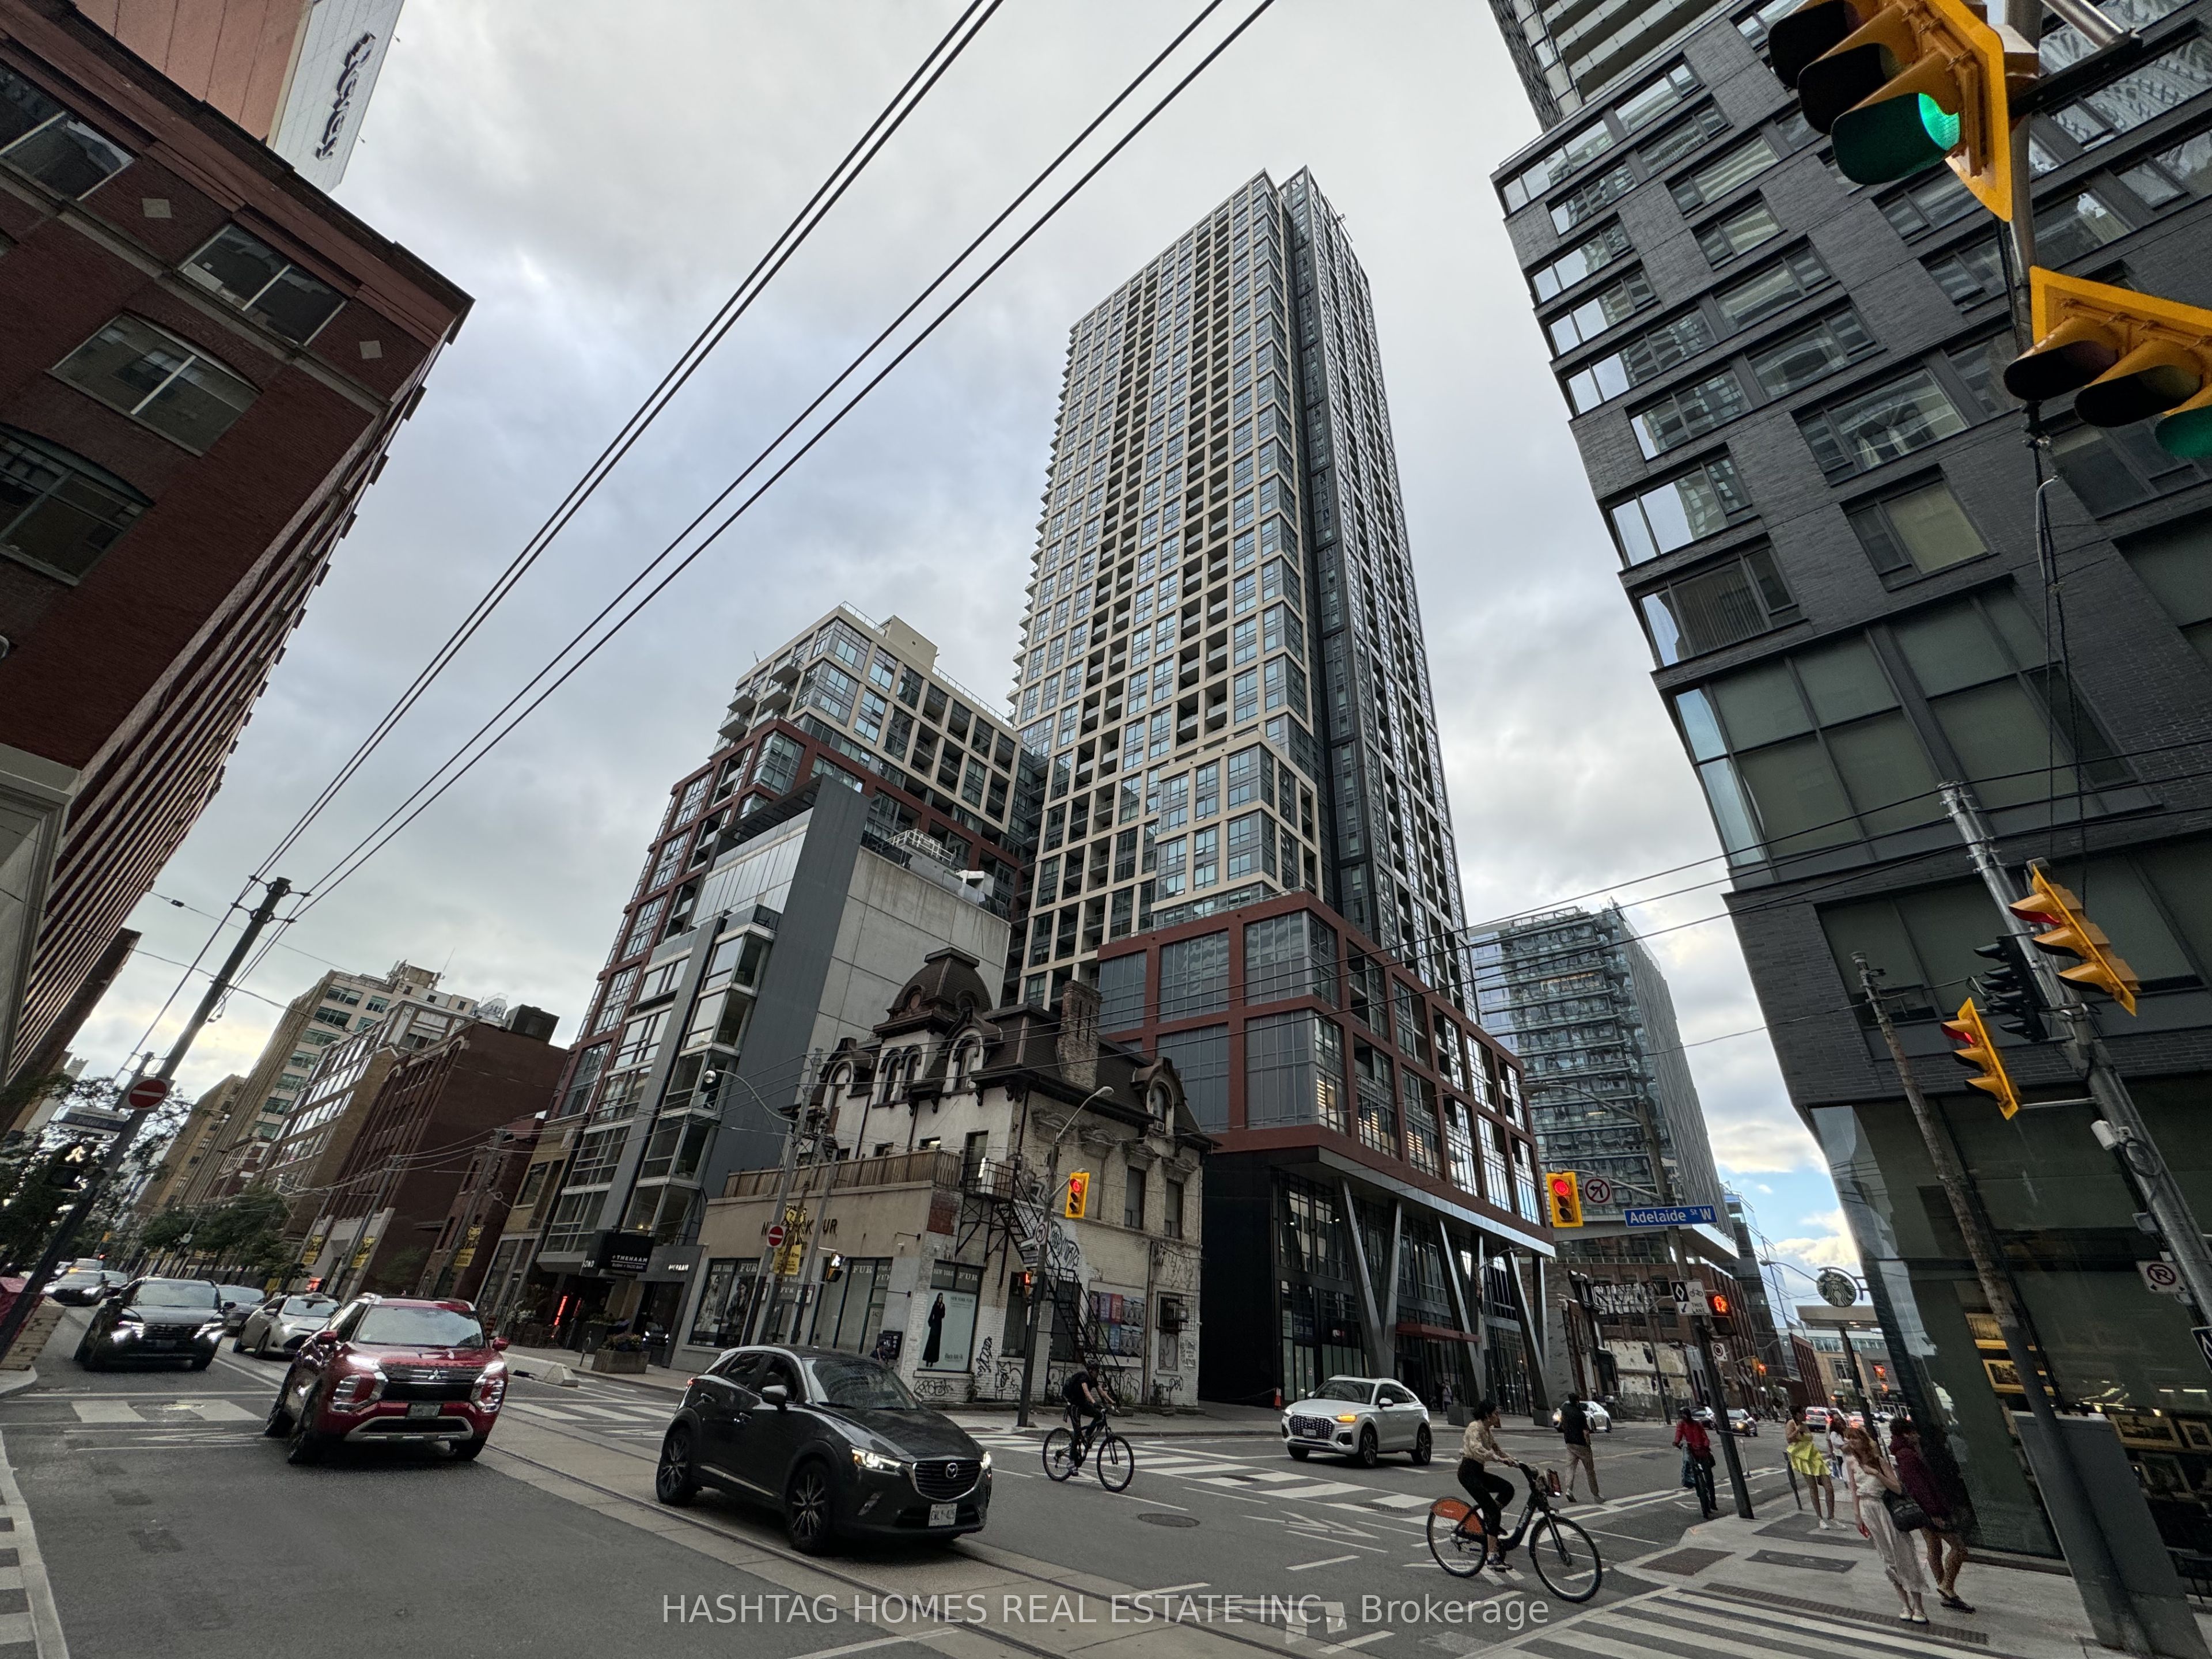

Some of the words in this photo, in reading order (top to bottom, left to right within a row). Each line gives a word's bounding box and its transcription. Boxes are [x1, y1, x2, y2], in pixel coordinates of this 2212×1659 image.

[1630, 1210, 1687, 1224] Adelaide
[1699, 1208, 1712, 1220] W
[821, 1218, 838, 1234] UR
[853, 1265, 872, 1273] FUR
[959, 1271, 978, 1281] FUR
